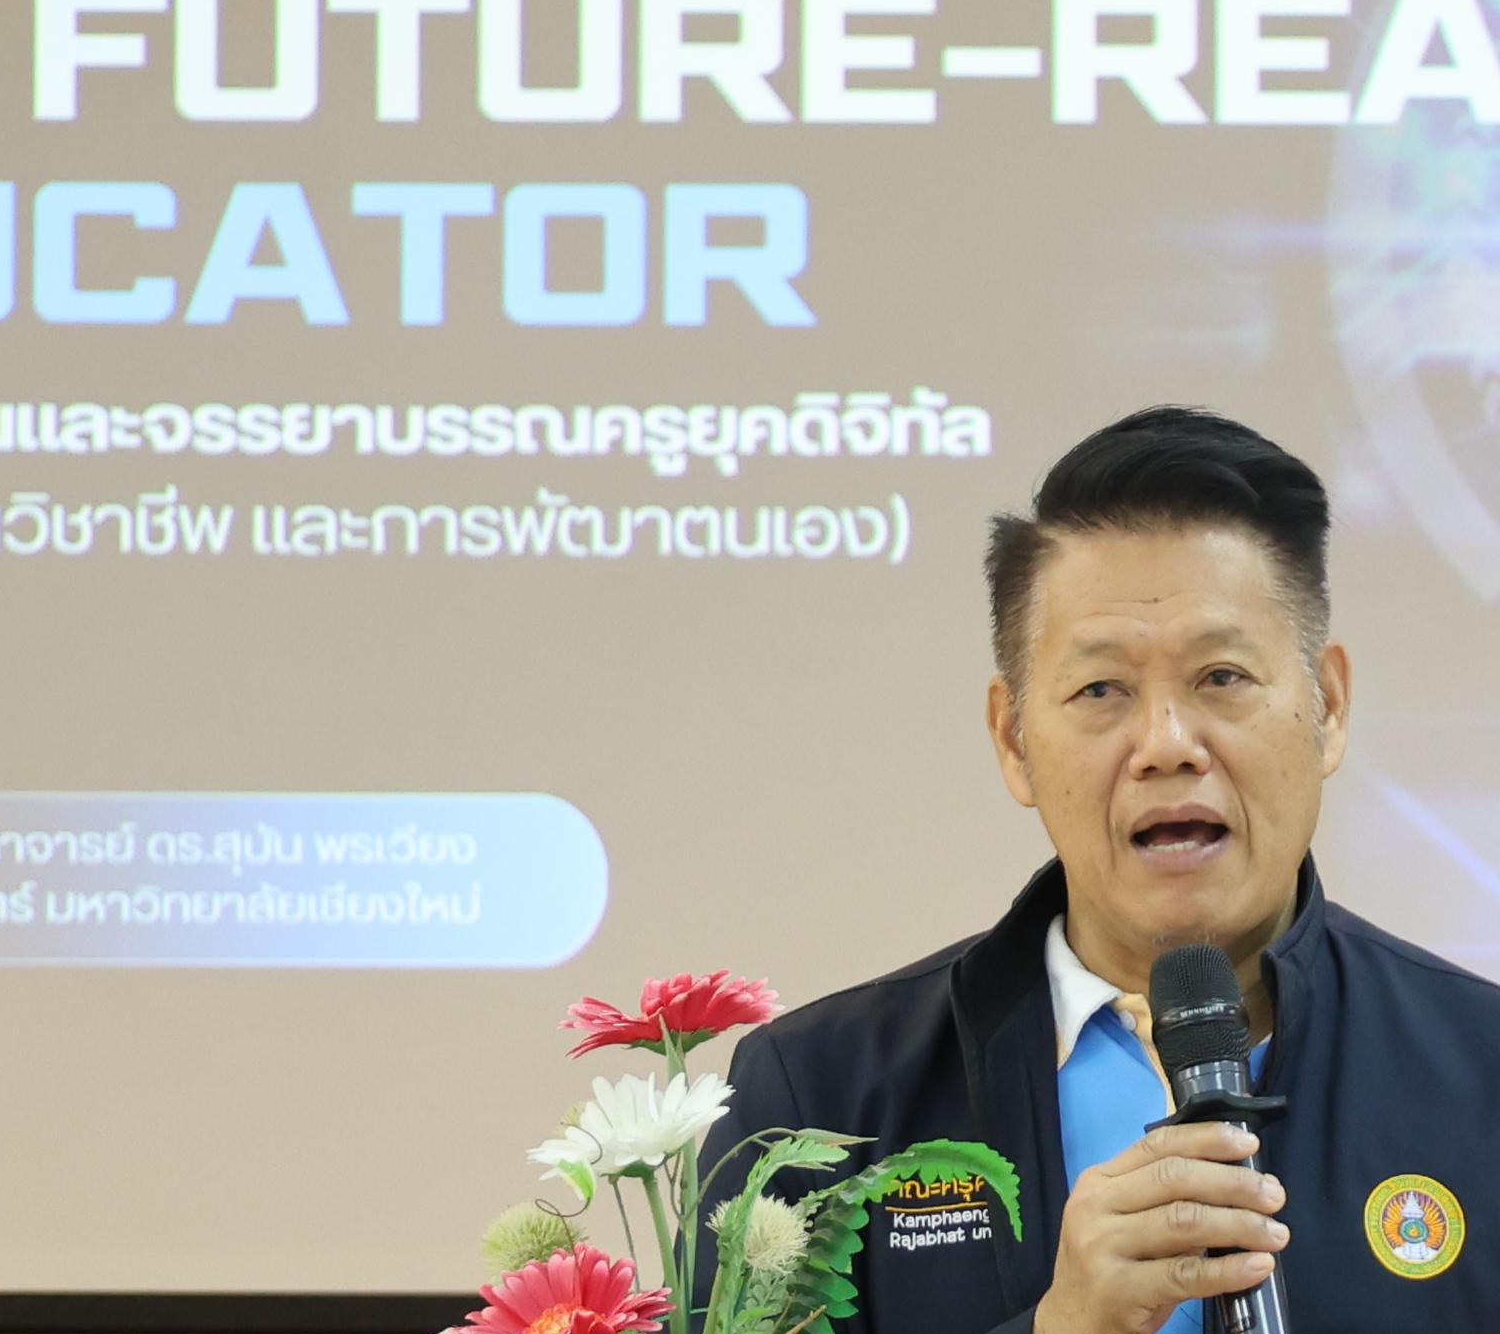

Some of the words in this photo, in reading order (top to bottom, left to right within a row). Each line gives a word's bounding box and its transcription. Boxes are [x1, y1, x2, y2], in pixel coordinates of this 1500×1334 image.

[46, 878, 482, 925] มหาวิทยาลัยเชียงใหม่
[889, 1227, 966, 1251] Rajabhat
